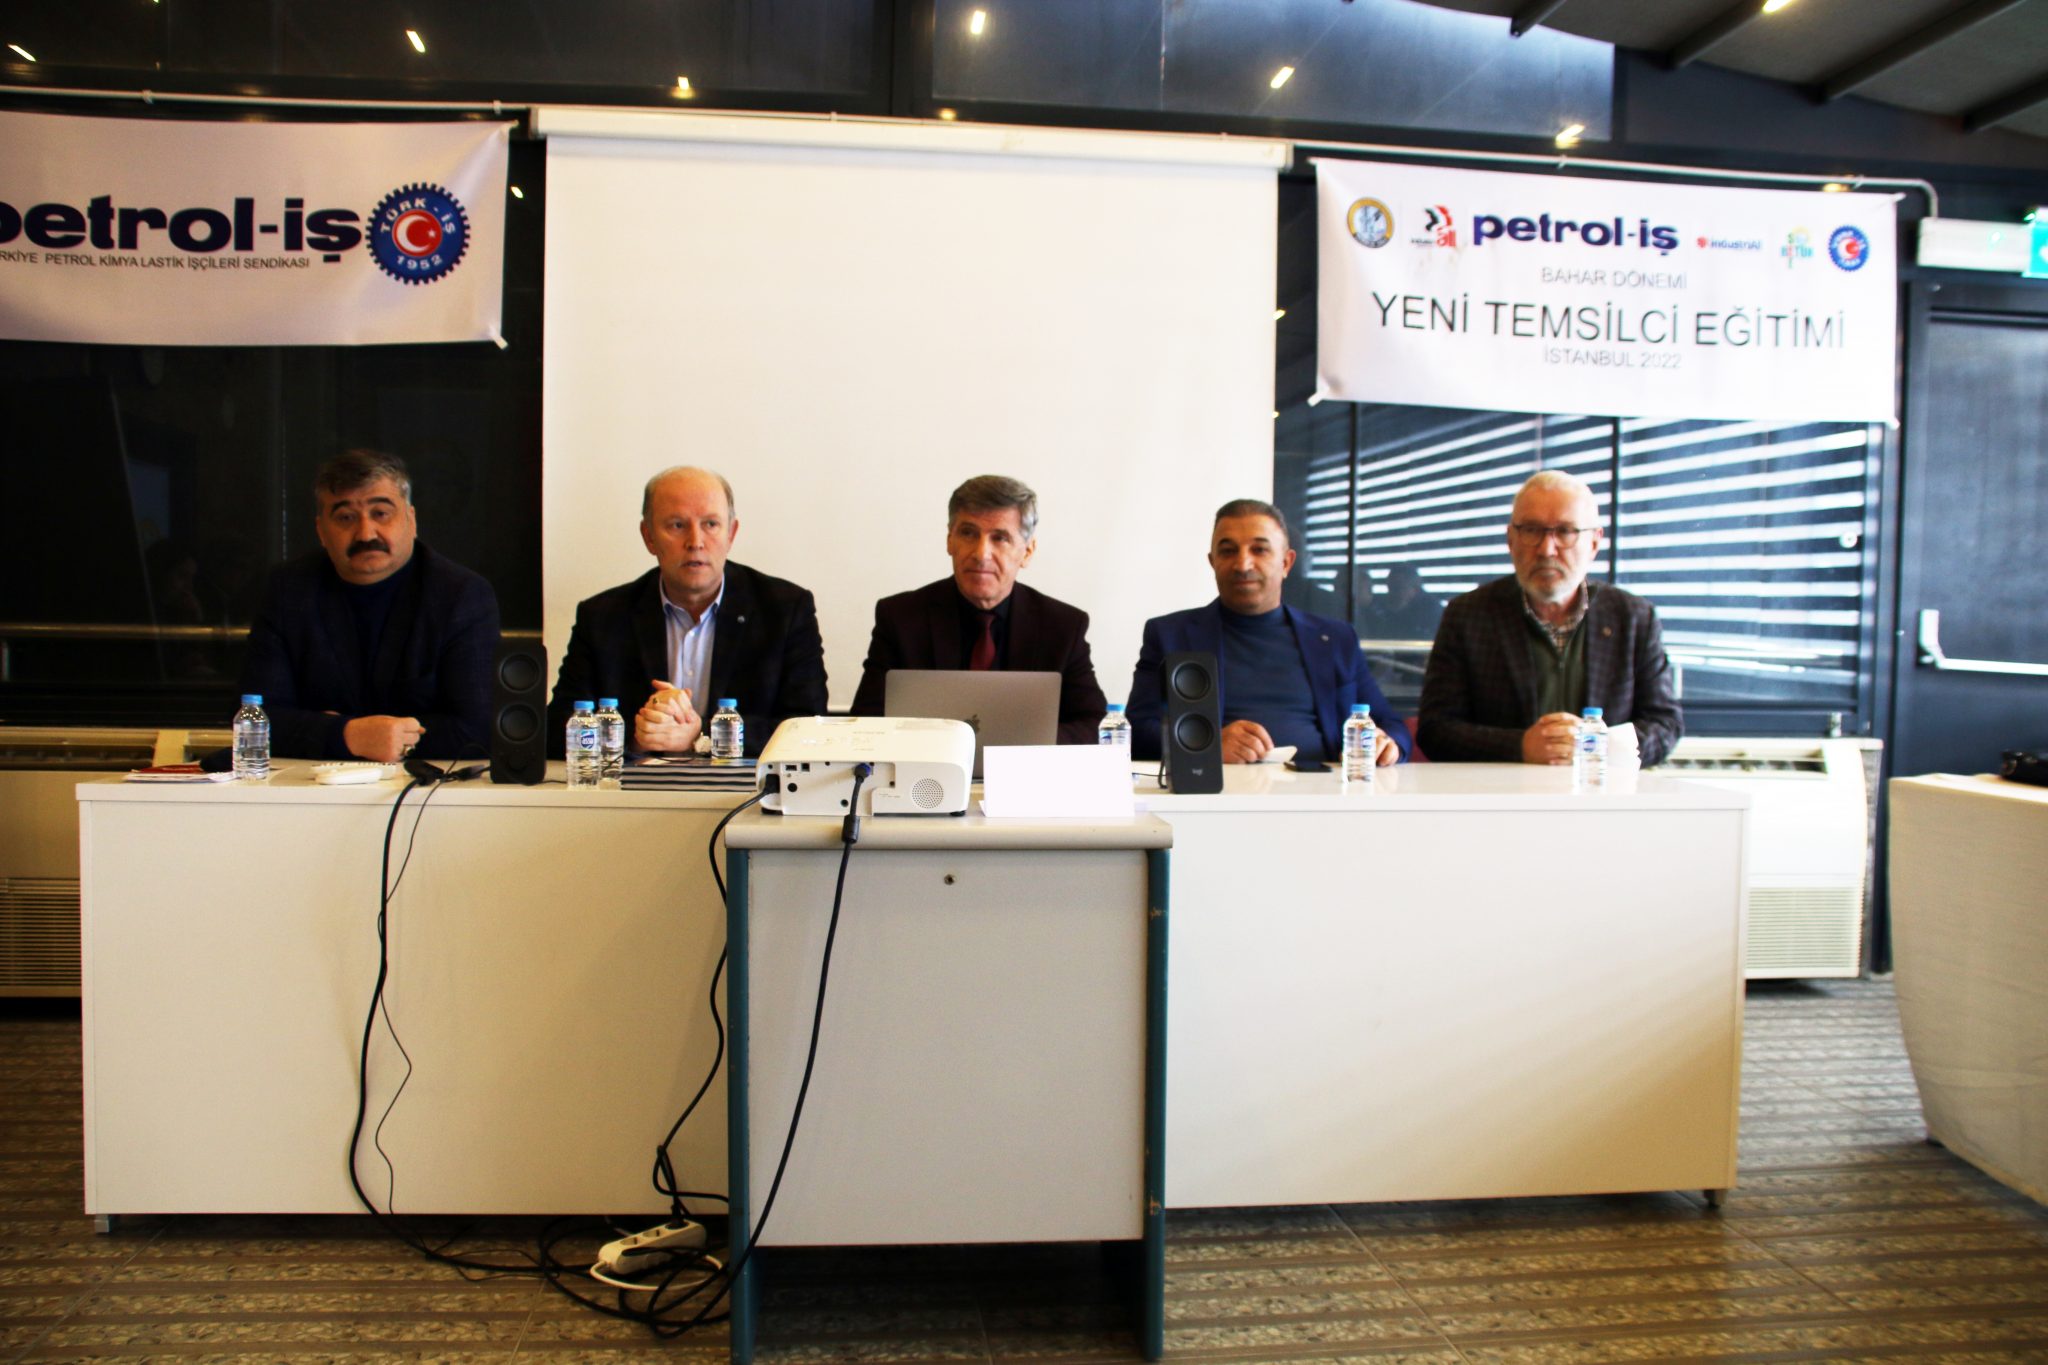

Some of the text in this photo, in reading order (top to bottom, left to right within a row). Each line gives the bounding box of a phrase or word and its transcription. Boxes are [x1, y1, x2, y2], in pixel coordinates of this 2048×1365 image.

[1473, 213, 1679, 256] petrol-iş
[45, 253, 96, 267] PETROL
[100, 254, 138, 268] KİMYA
[141, 256, 184, 269] LASTİK
[188, 256, 239, 271] İŞÇİLERİ
[243, 258, 309, 269] SENDİKASI
[1542, 267, 1606, 285] BAHAR
[1372, 291, 1845, 348] YENİ TEMSİLCİ EĞİTİMİ
[1543, 345, 1682, 368] İSTANBUL 2022
